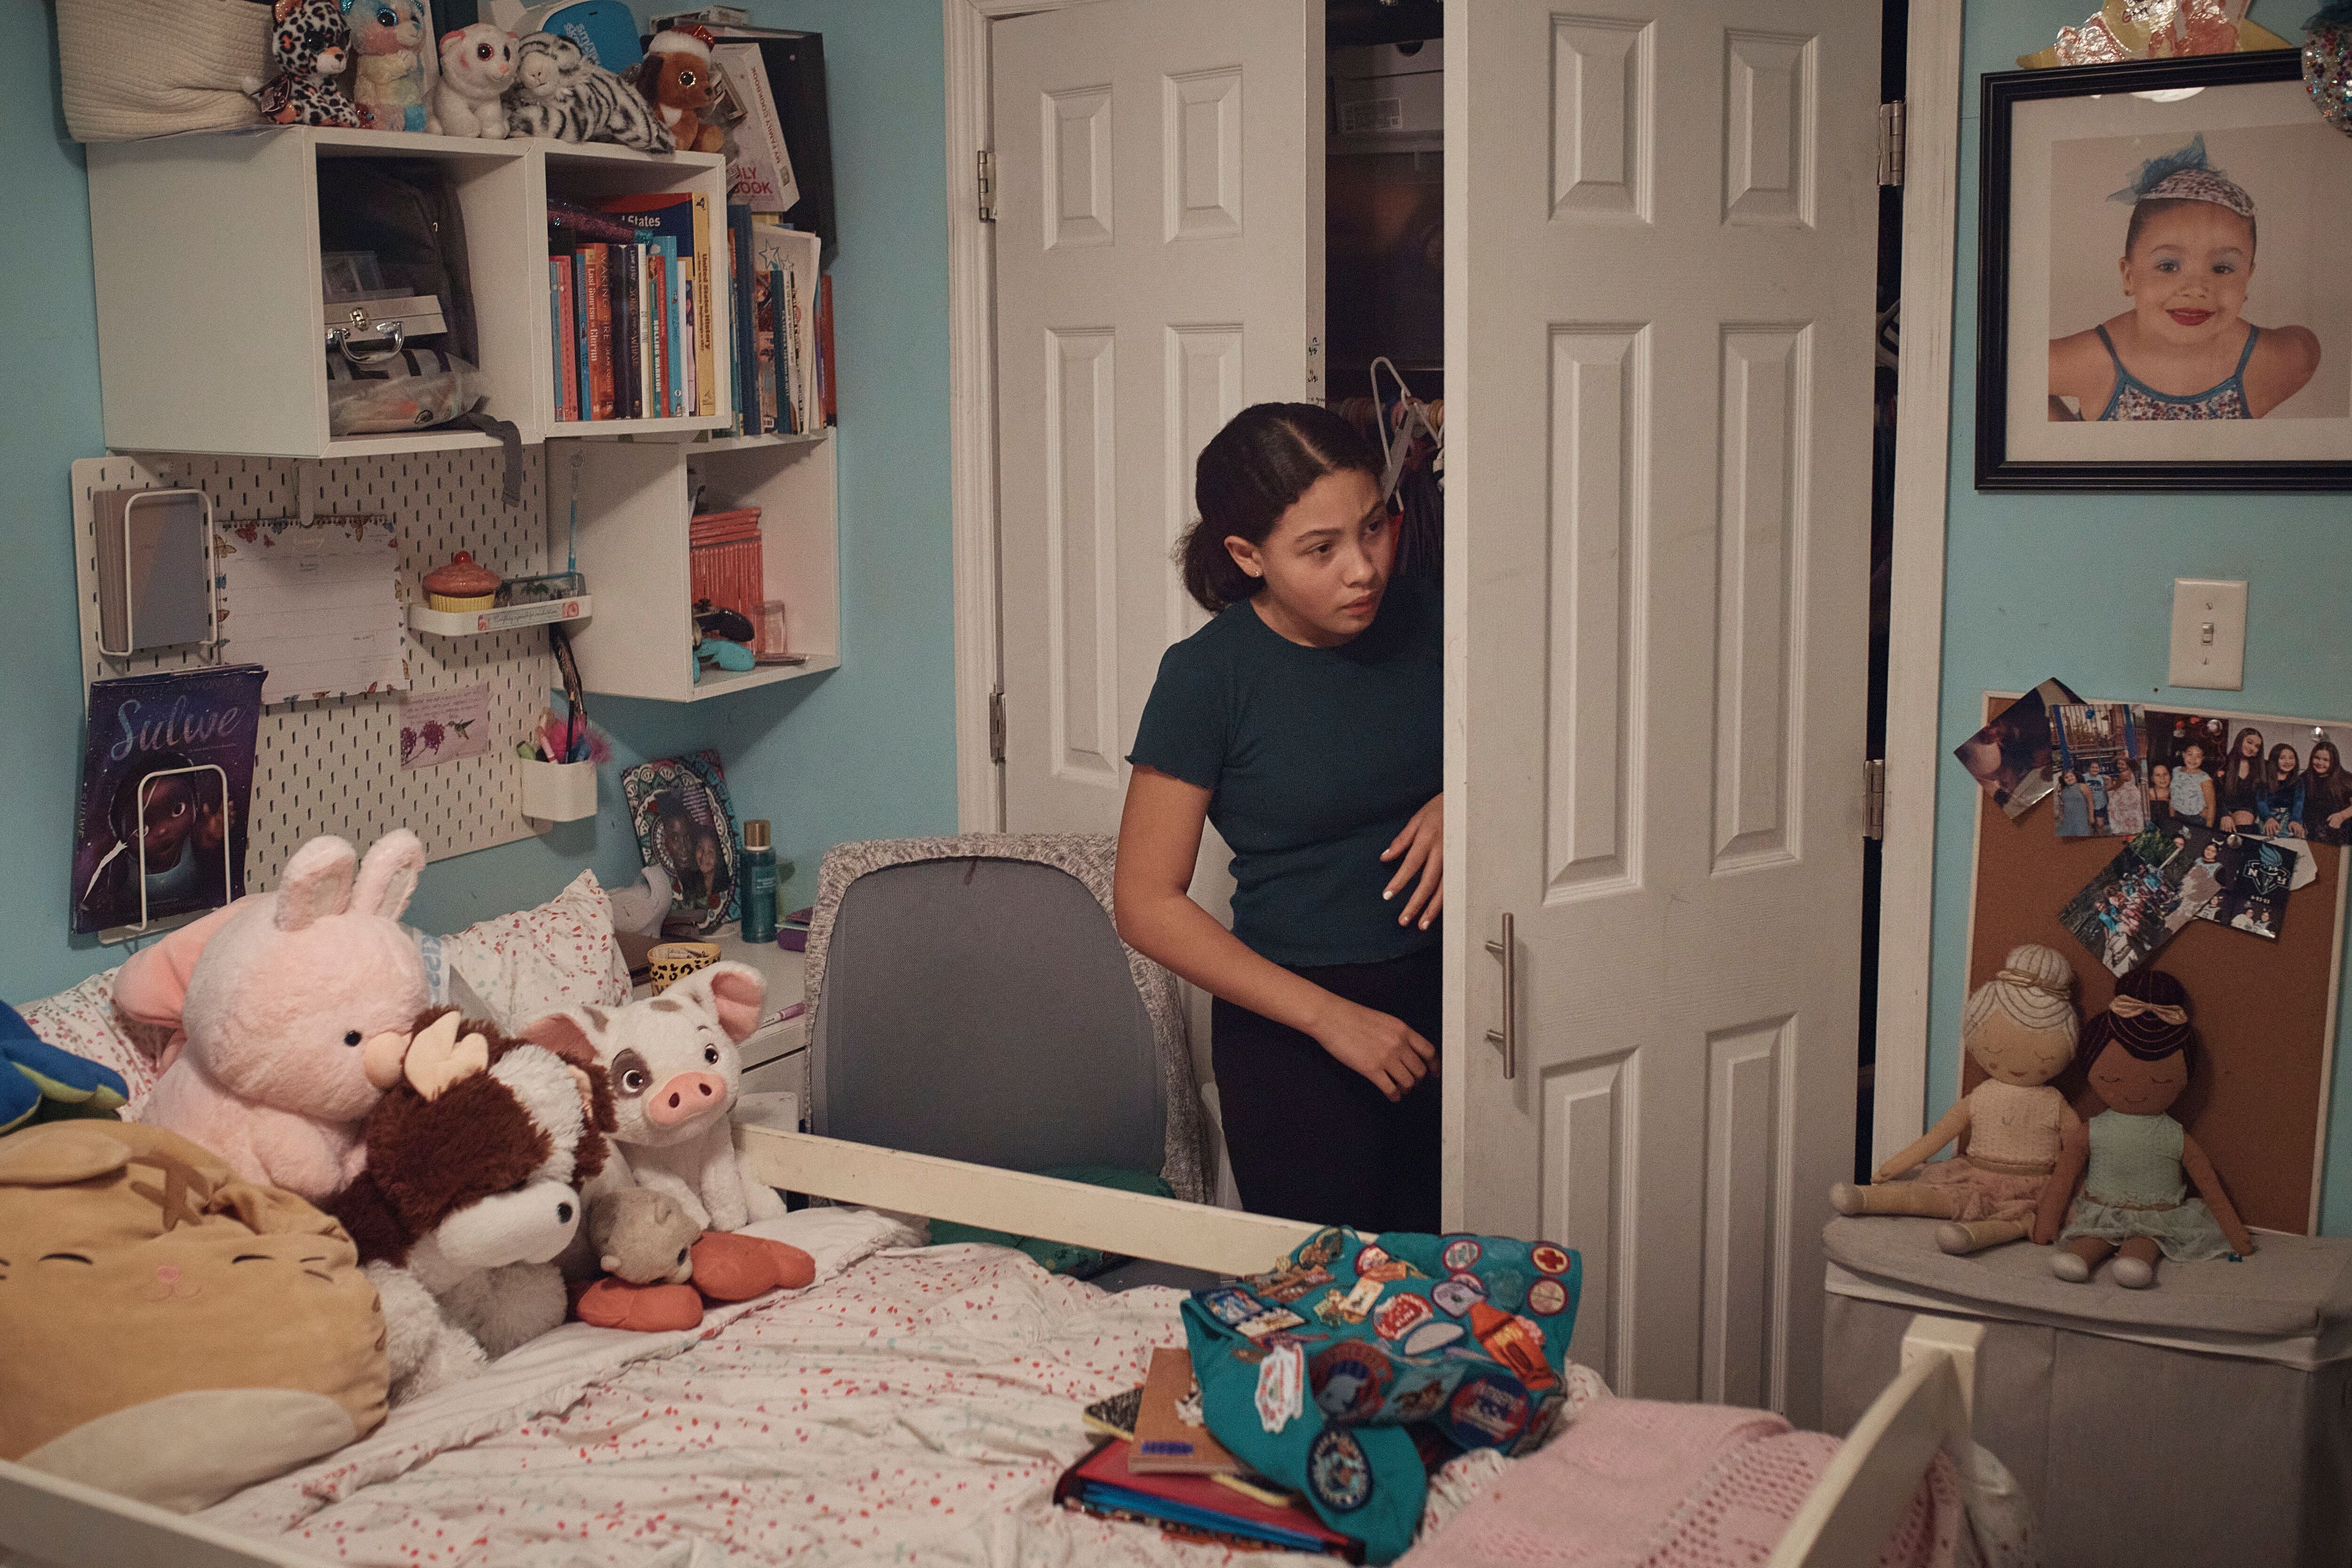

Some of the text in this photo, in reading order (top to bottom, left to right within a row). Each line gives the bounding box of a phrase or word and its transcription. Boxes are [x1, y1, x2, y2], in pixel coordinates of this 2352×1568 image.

[751, 66, 781, 164] MY FAMILY COOKBOOK
[628, 215, 661, 227] States
[600, 252, 609, 307] WAKING
[629, 284, 638, 314] SONG
[588, 286, 597, 320] Sunrise
[589, 328, 598, 361] Eterna
[110, 695, 246, 761] Sulwe
[77, 791, 88, 839] SULWE
